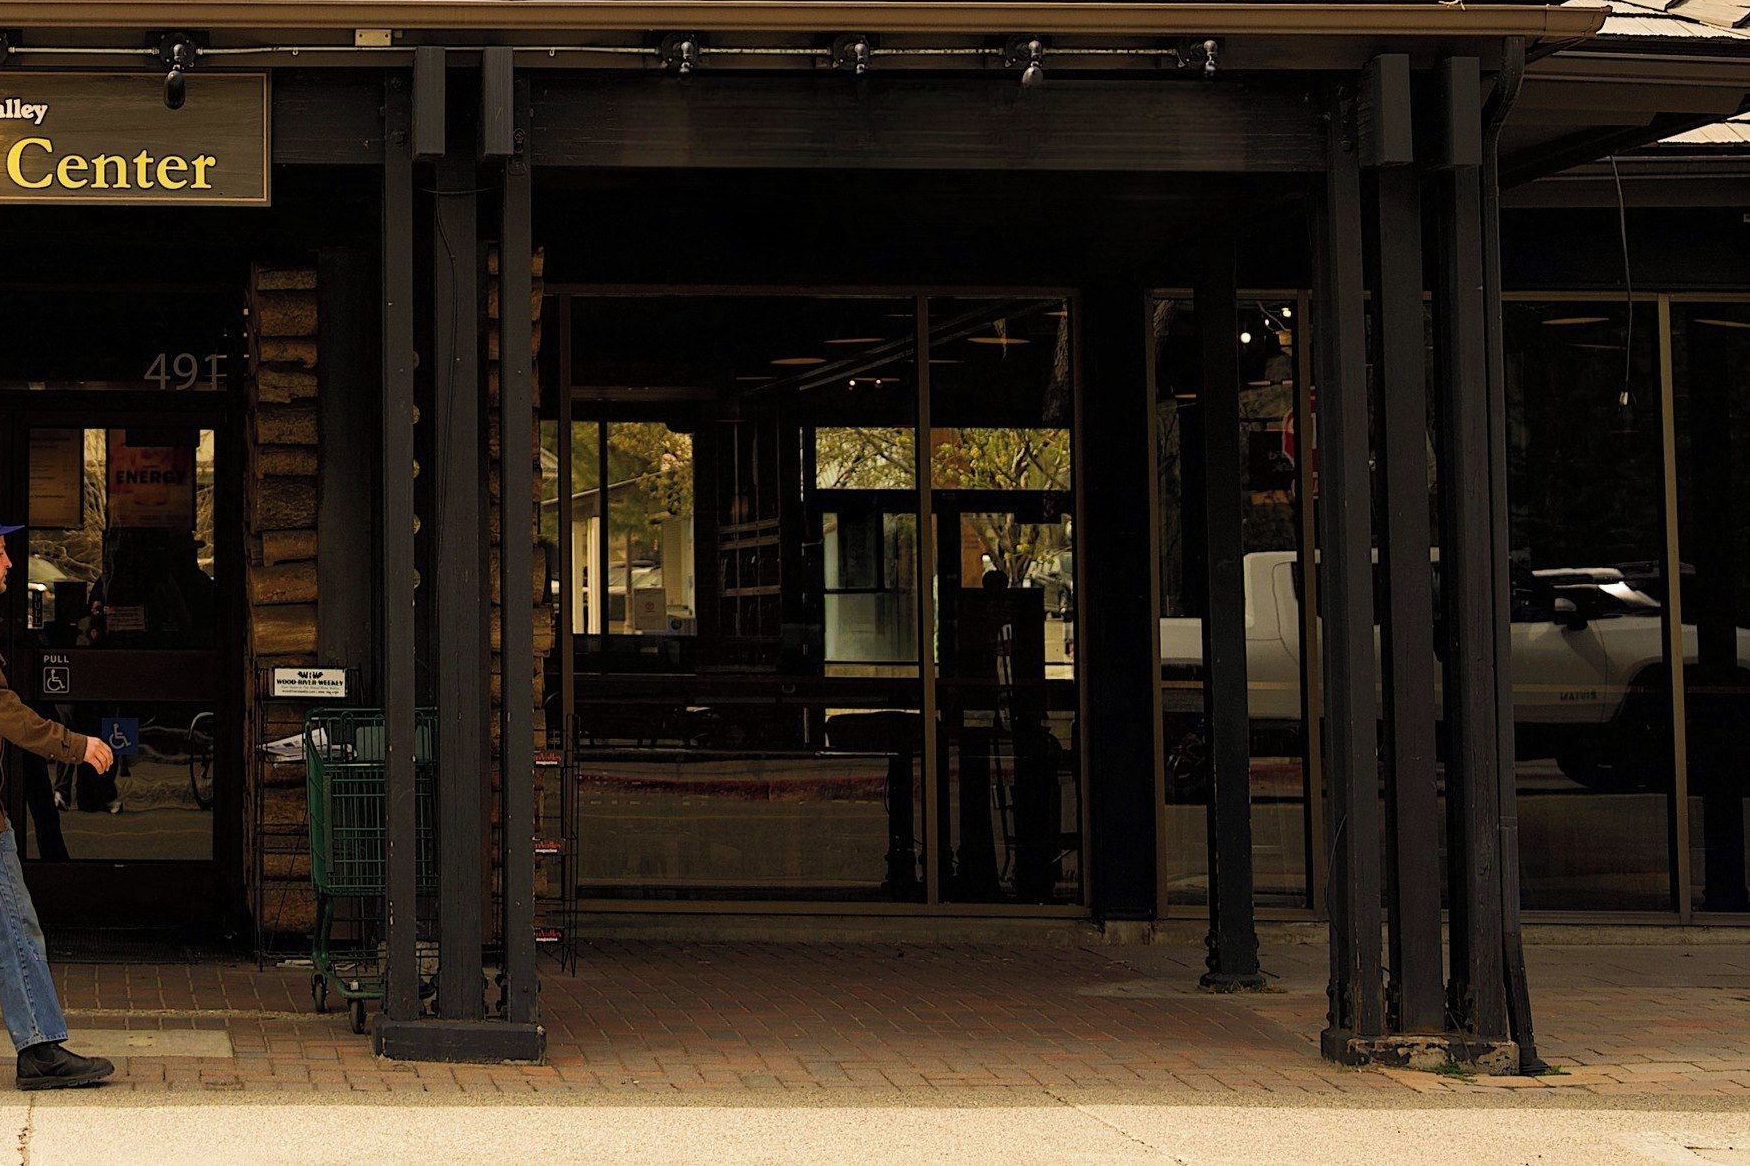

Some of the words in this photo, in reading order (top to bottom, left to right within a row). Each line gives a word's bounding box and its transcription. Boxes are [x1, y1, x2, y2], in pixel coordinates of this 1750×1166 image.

[6, 137, 217, 190] Center
[116, 470, 187, 484] ENERGY
[43, 654, 70, 664] PULL
